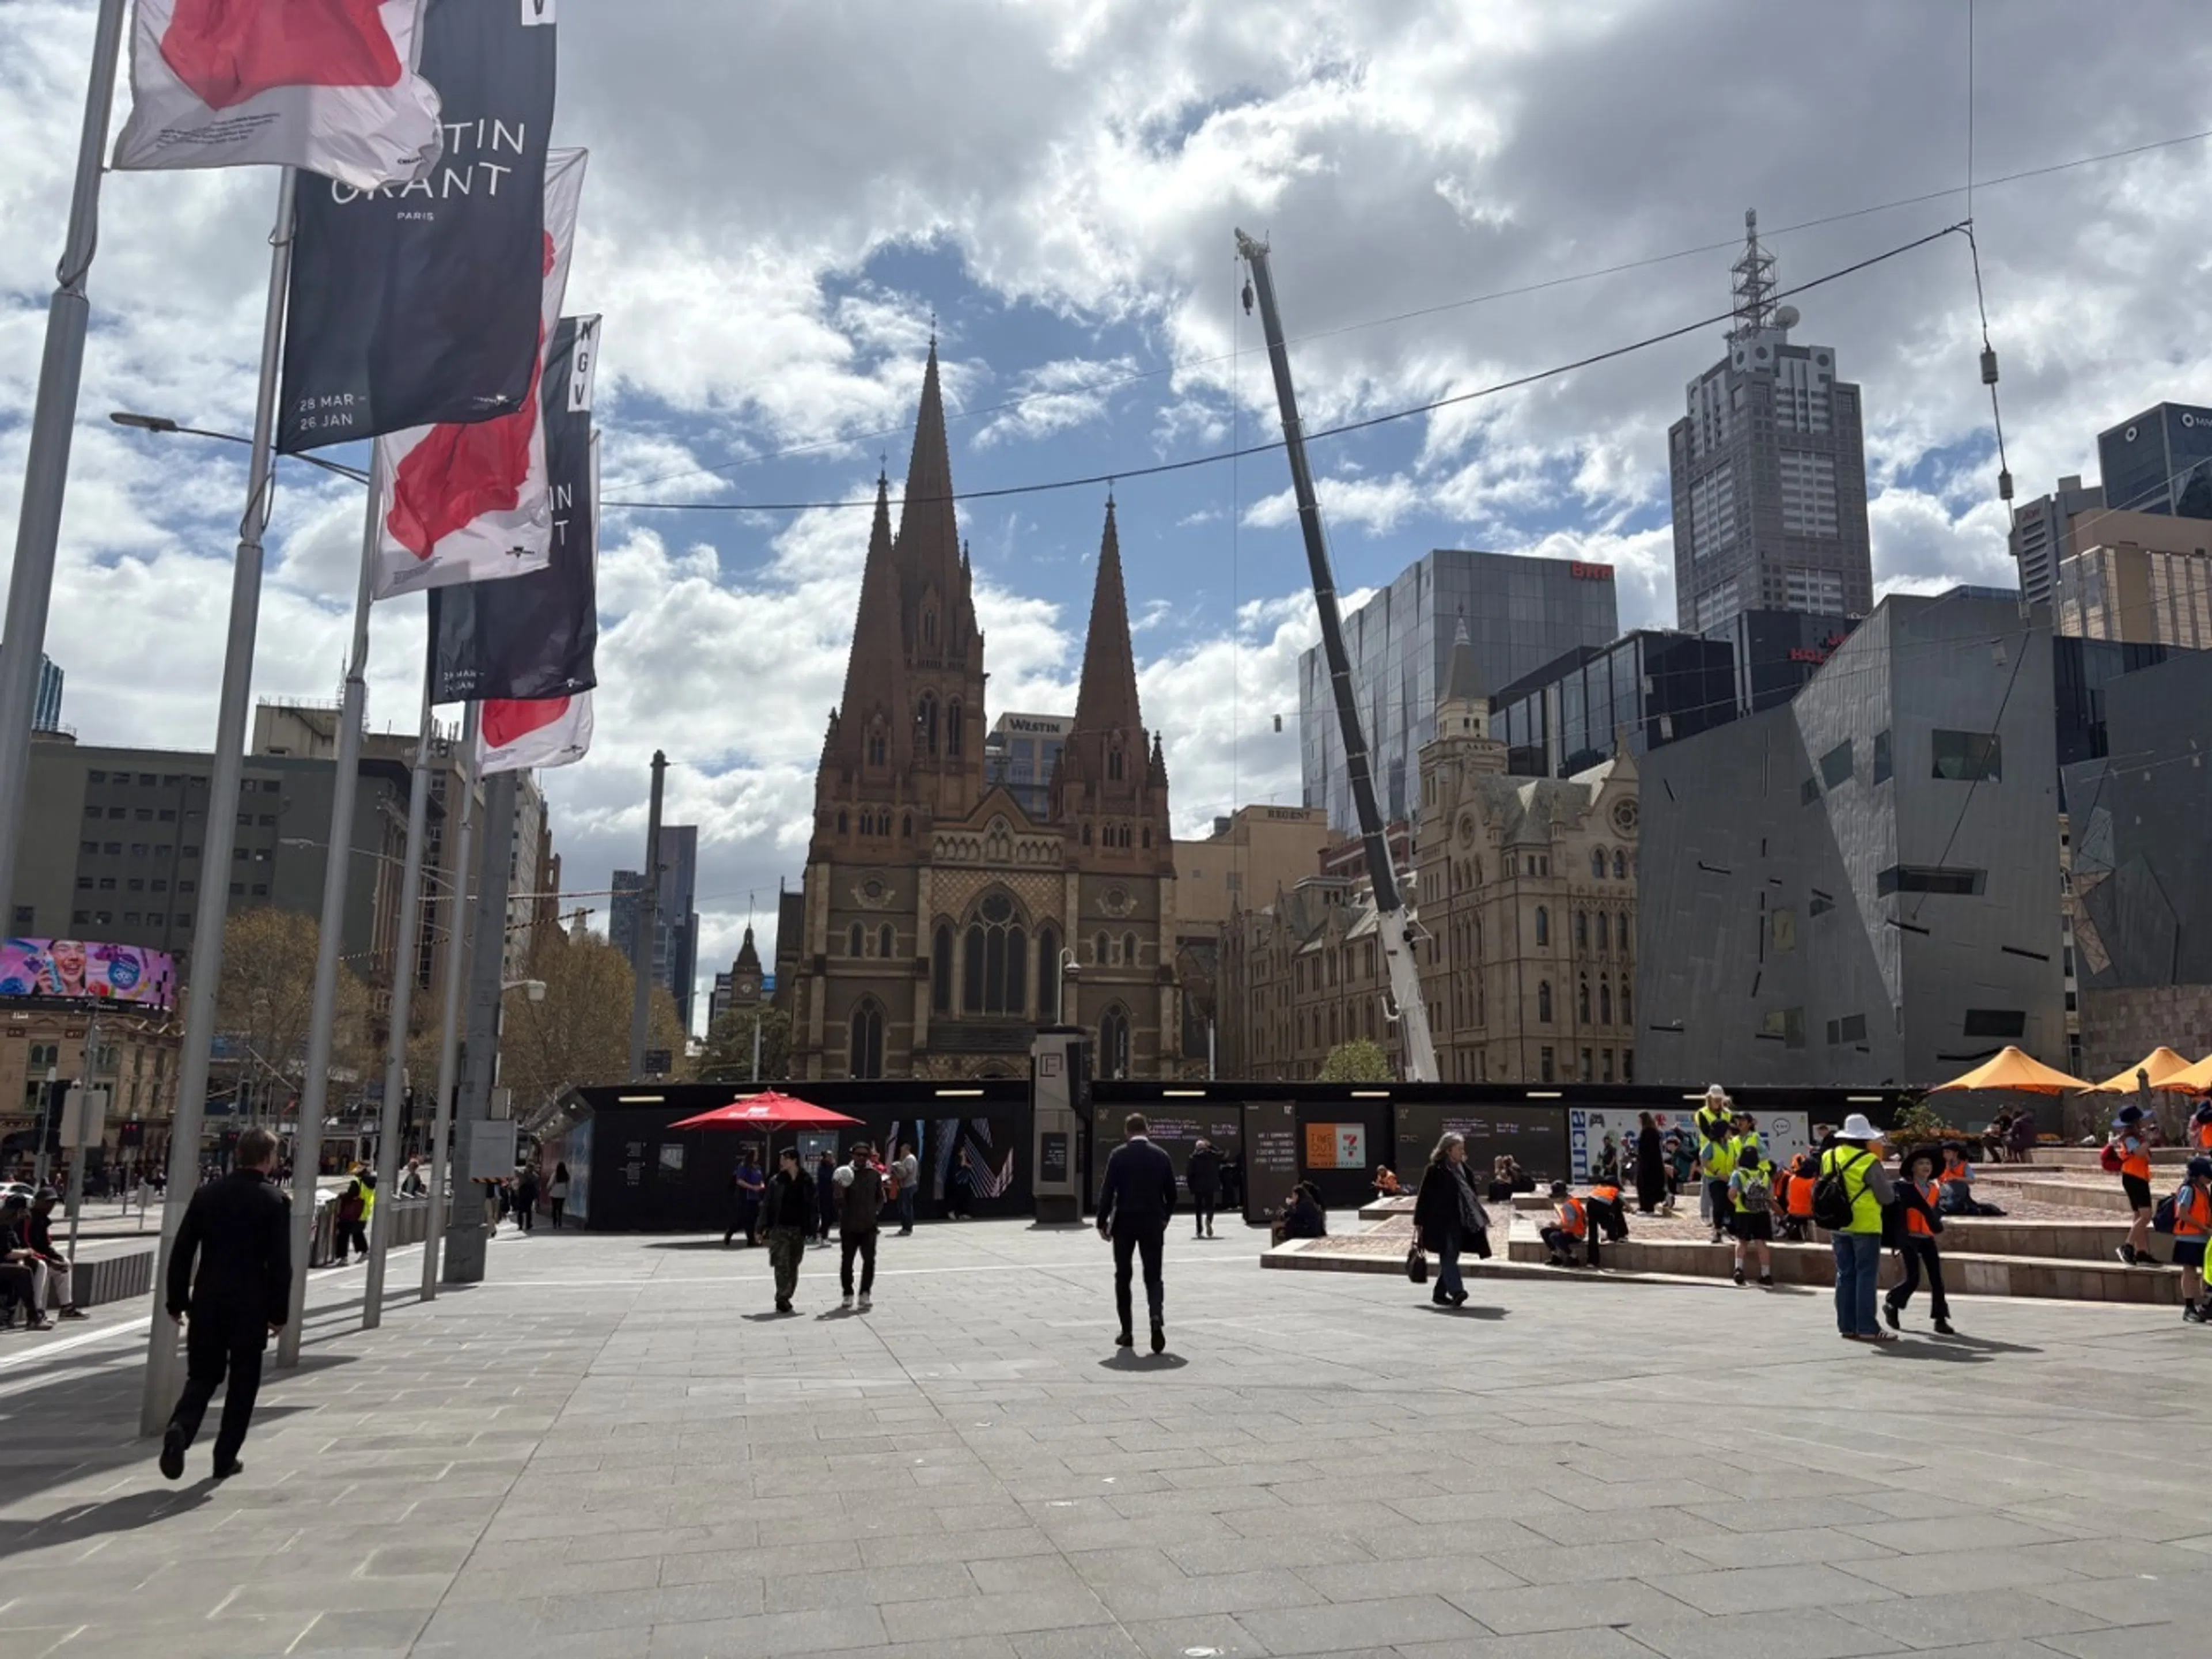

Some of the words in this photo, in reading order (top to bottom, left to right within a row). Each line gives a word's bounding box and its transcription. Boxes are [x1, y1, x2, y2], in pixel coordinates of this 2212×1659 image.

[444, 118, 525, 154] TIN
[397, 212, 434, 221] PARIS
[300, 397, 316, 412] 28
[320, 393, 354, 408] MAR
[300, 416, 316, 431] 26
[323, 413, 353, 427] JAN
[1010, 718, 1060, 733] WESTIN
[1268, 809, 1311, 821] REGENT
[1571, 1111, 1588, 1185] acm
